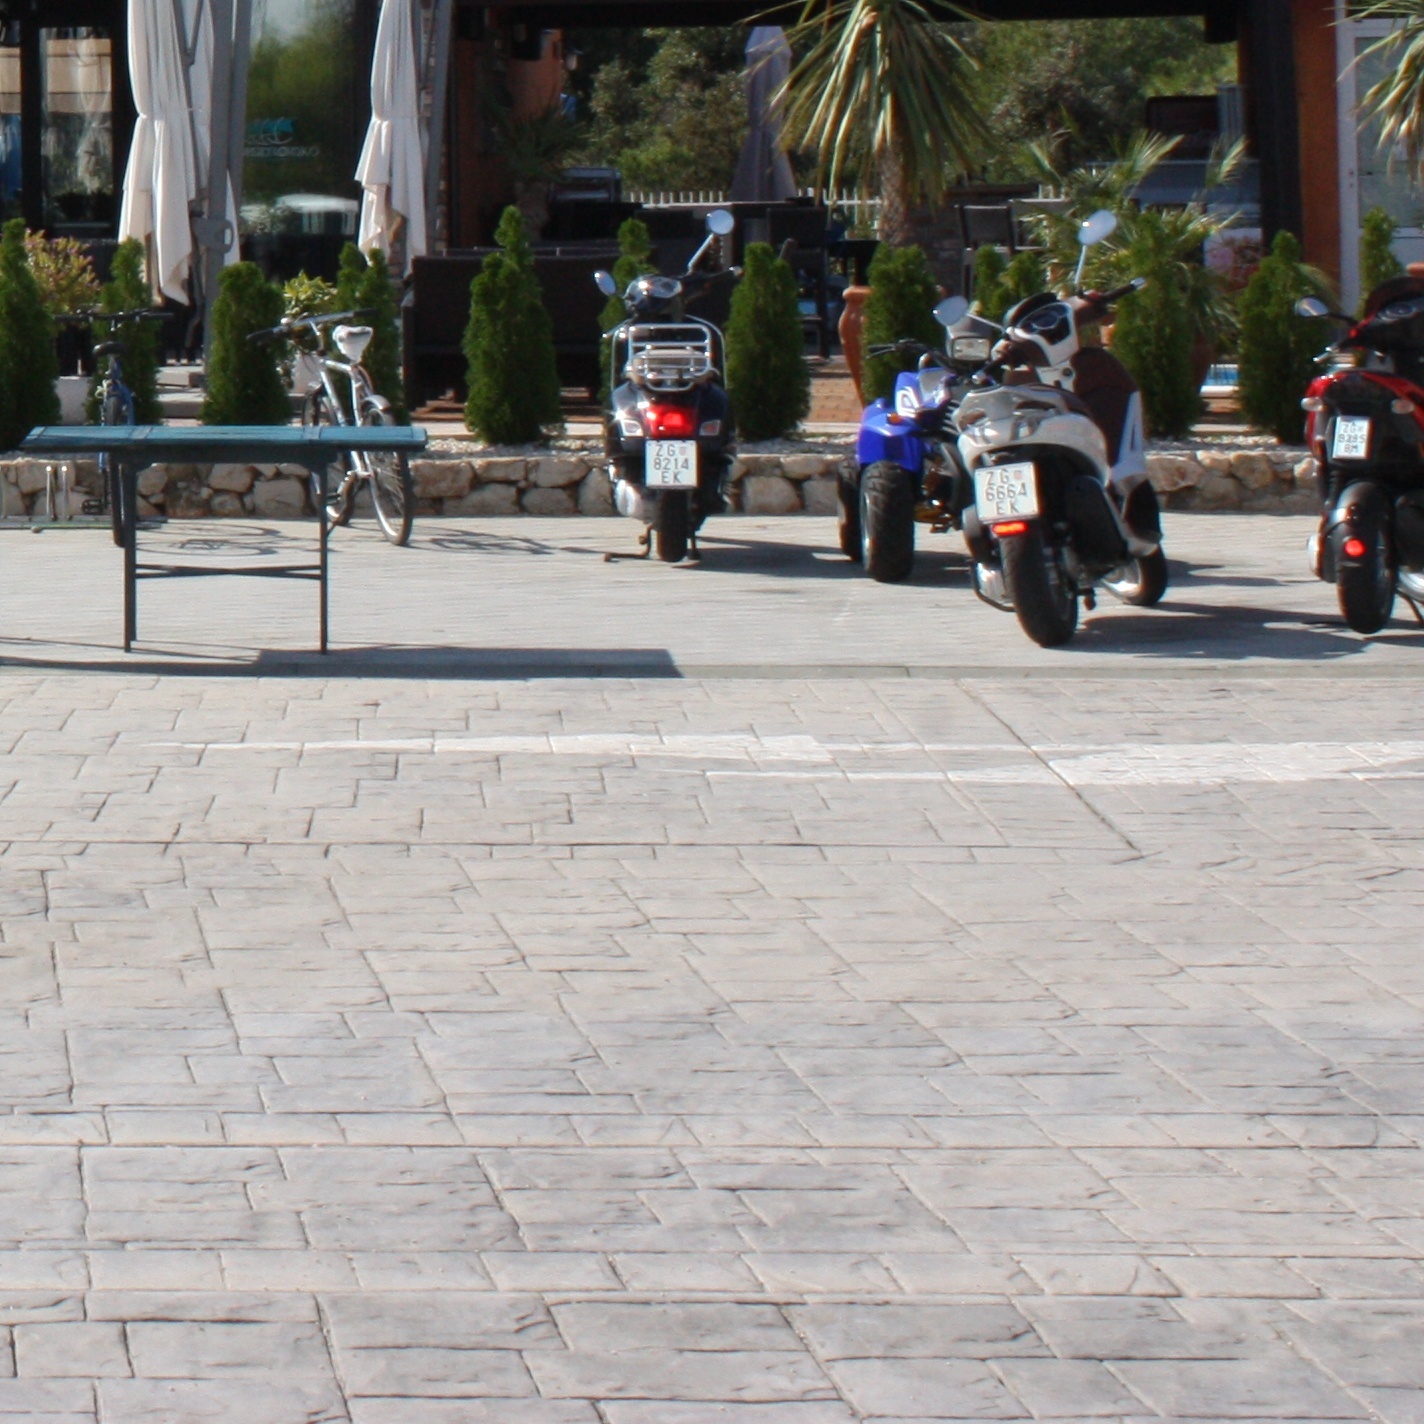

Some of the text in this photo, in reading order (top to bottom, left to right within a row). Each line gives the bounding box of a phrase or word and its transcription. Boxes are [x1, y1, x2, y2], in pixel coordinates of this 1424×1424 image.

[655, 443, 676, 457] ZG
[653, 457, 690, 470] 8214
[661, 470, 682, 484] EK
[986, 467, 1010, 486] ZG
[985, 482, 1028, 502] 6664
[995, 498, 1020, 515] EK
